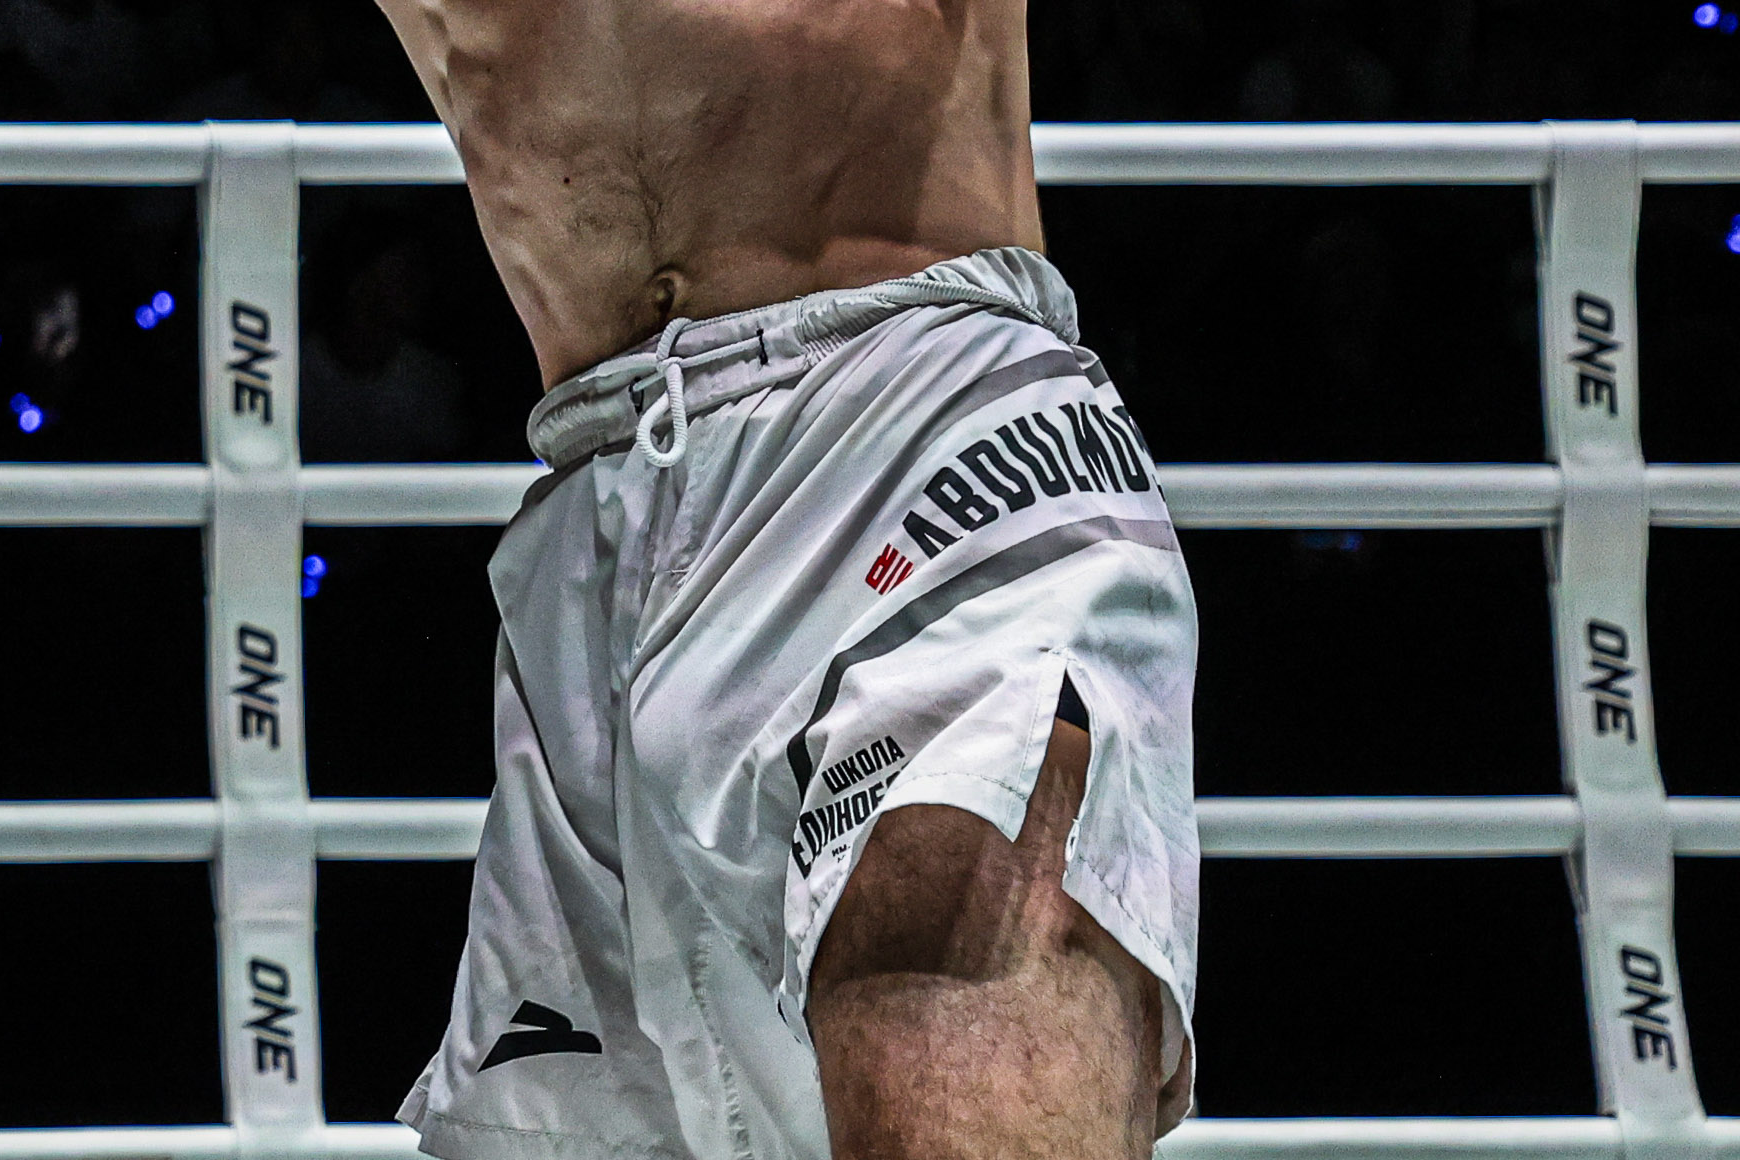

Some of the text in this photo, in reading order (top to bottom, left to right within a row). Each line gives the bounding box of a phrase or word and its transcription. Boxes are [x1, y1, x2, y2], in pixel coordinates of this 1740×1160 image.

[227, 300, 277, 426] ONE
[1571, 290, 1620, 417] ONE
[232, 624, 283, 749] ONE
[1584, 619, 1638, 744] ONE
[821, 735, 905, 795] ШКОЛА
[245, 957, 298, 1083] ONE
[1619, 945, 1676, 1071] ONE
